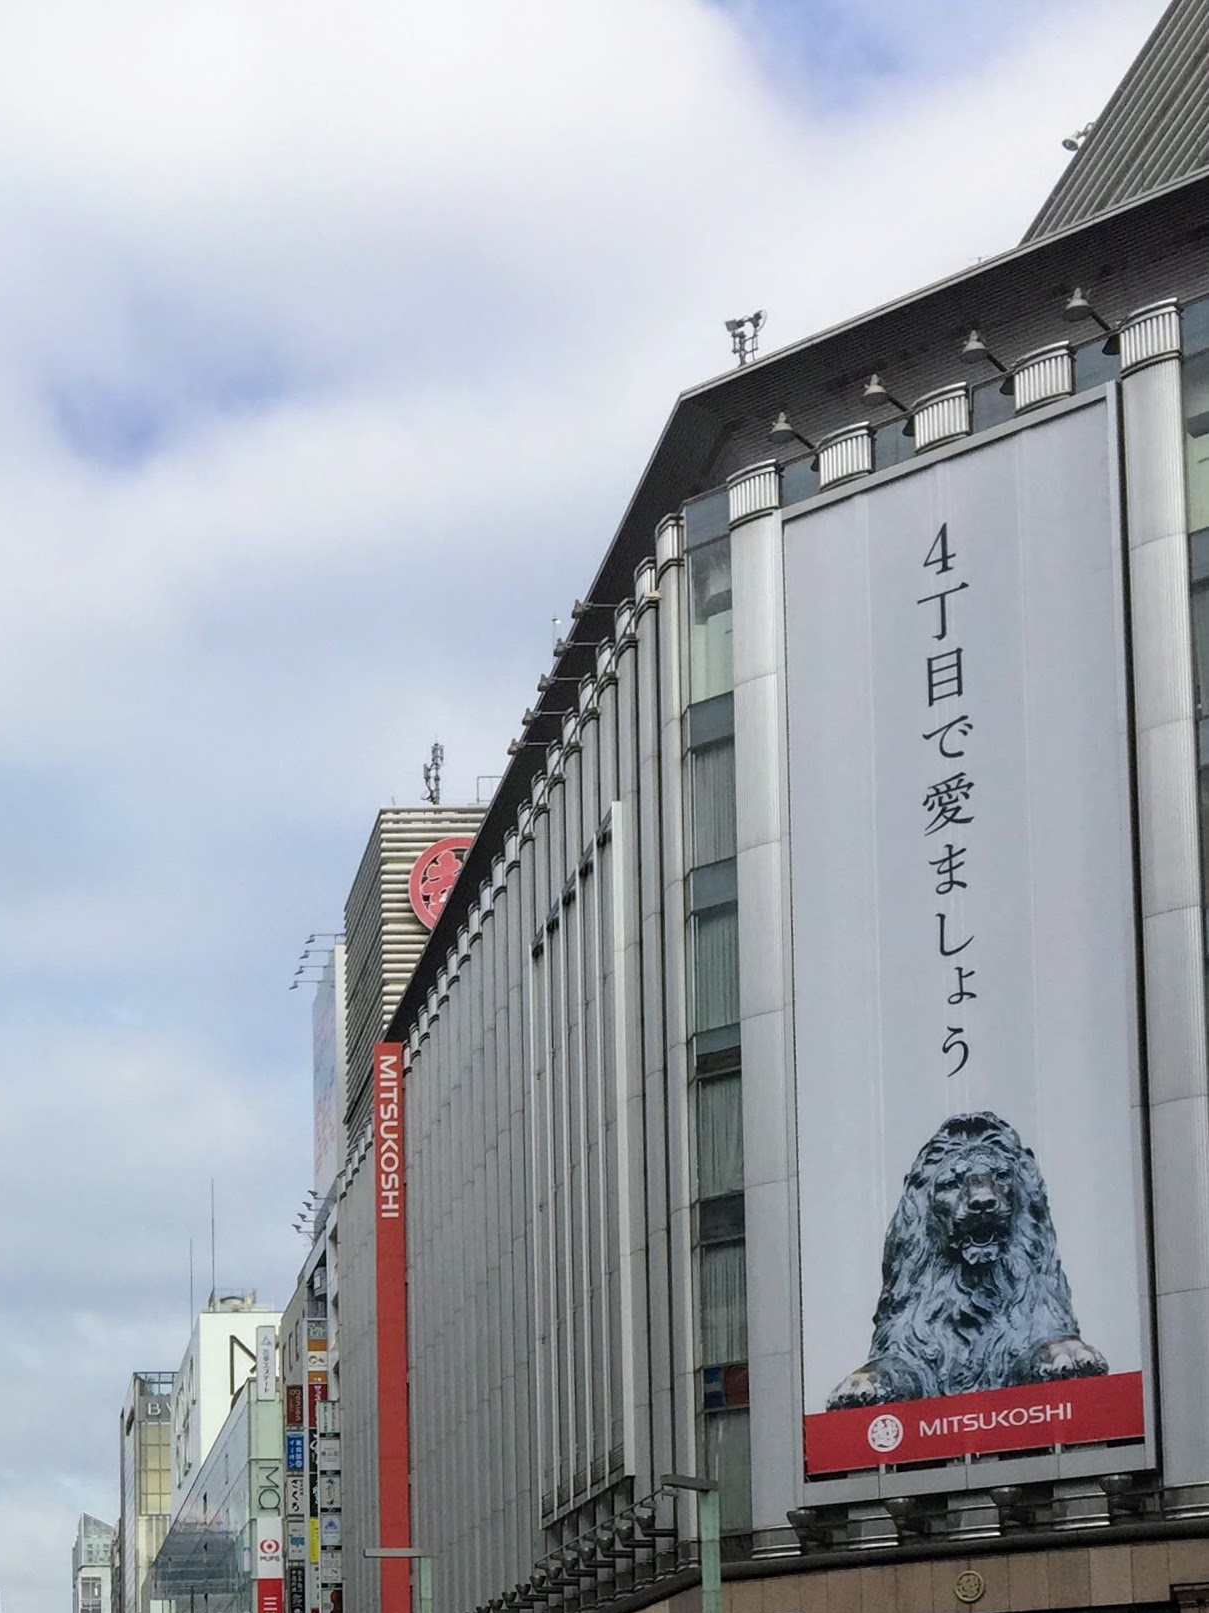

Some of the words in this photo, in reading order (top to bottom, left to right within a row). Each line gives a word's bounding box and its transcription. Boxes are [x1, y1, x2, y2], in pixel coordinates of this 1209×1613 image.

[917, 522, 977, 1078] 4丁目で愛ましょう
[380, 1055, 399, 1219] MITSUKOSHI
[919, 1402, 1072, 1437] MITSUKOSHI
